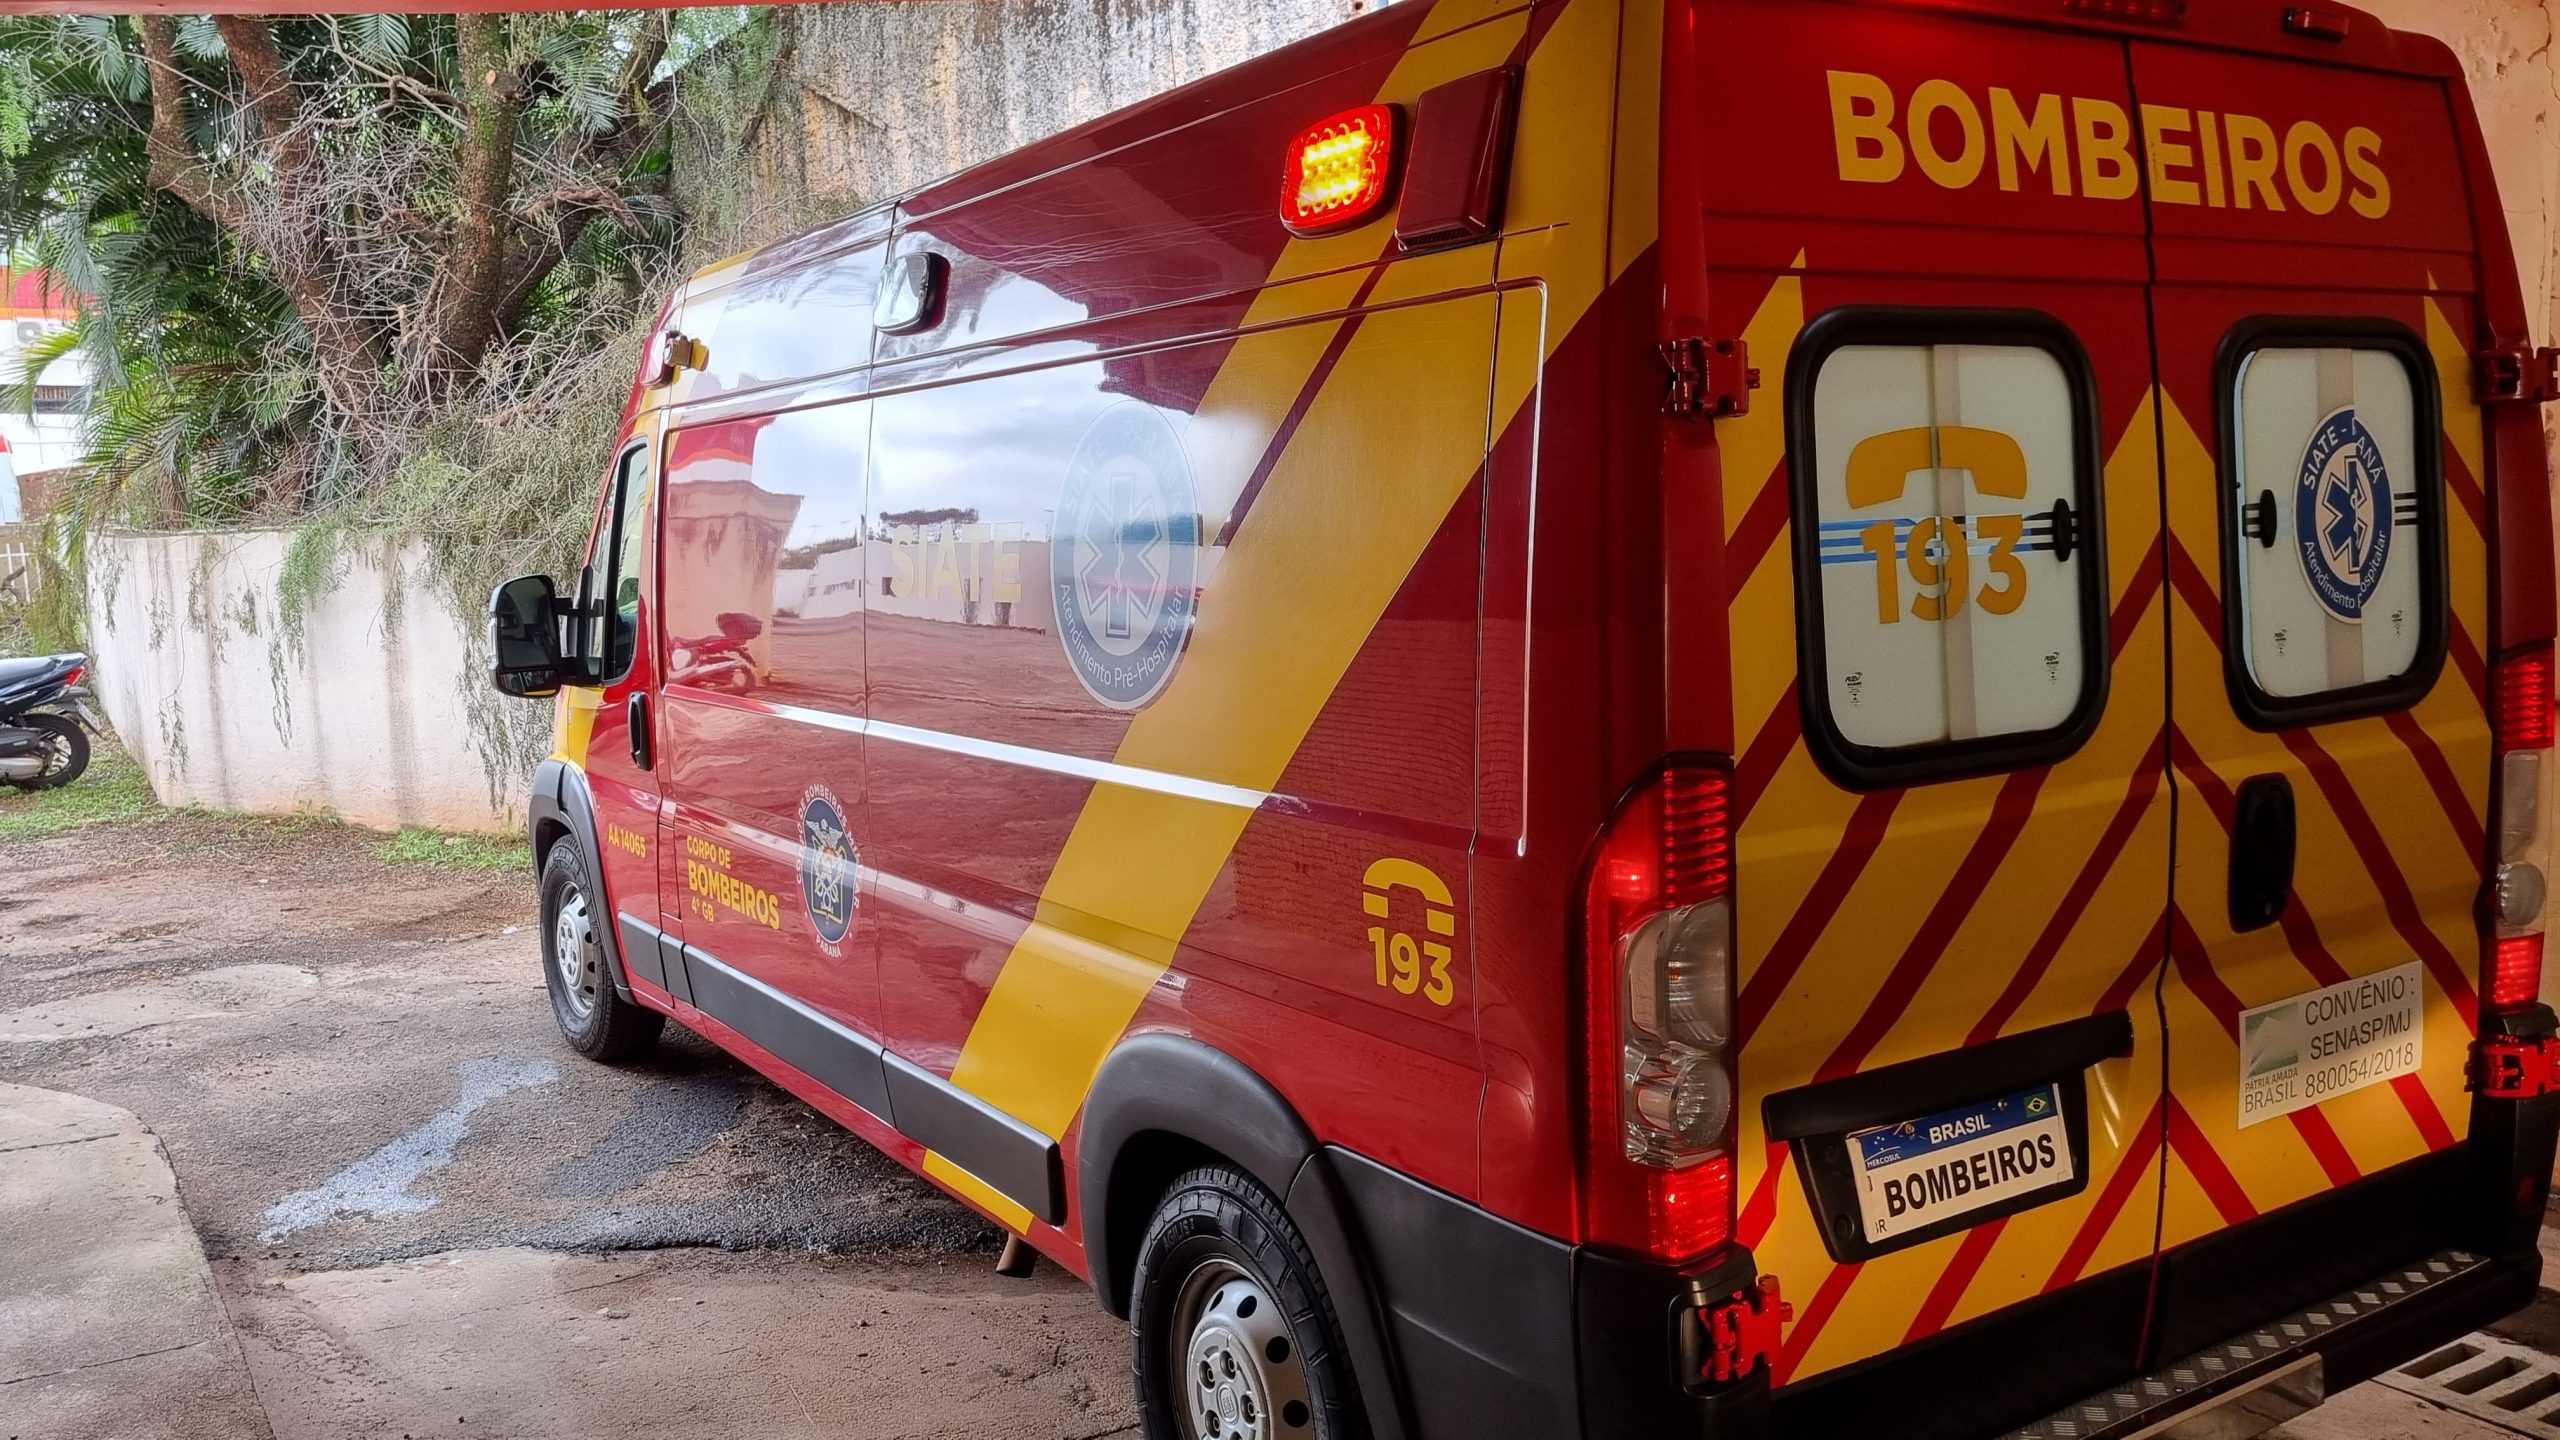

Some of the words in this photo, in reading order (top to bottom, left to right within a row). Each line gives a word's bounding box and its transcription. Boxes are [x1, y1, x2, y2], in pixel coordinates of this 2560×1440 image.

[1826, 69, 2392, 220] BOMBEIROS
[2304, 425, 2339, 490] SIATE
[889, 519, 1023, 603] SIATE
[1860, 513, 2028, 624] 193
[2304, 541, 2355, 608] Atendimento
[1060, 583, 1111, 686] Atendimento
[1114, 586, 1184, 688] Pré-Hospitalar
[804, 783, 847, 827] BOMBEIROS
[609, 823, 620, 848] AA
[621, 828, 646, 859] 14065
[687, 835, 716, 863] CORPO
[719, 847, 731, 869] DE
[688, 859, 780, 930] BOMBEIROS
[702, 901, 715, 922] GB
[815, 934, 842, 958] PARANÁ
[1367, 926, 1454, 1006] 193
[2305, 975, 2405, 1026] CONVÊNIO
[2310, 1008, 2412, 1061] SENASP/MJ
[2245, 1080, 2298, 1114] BRASIL
[2271, 1067, 2299, 1084] AMADA
[2305, 1042, 2414, 1099] 880054/2018
[1929, 1113, 1992, 1145] BRASIL
[1867, 1152, 1901, 1168] MERCOSUL
[1883, 1133, 2056, 1218] BOMBEIROS
